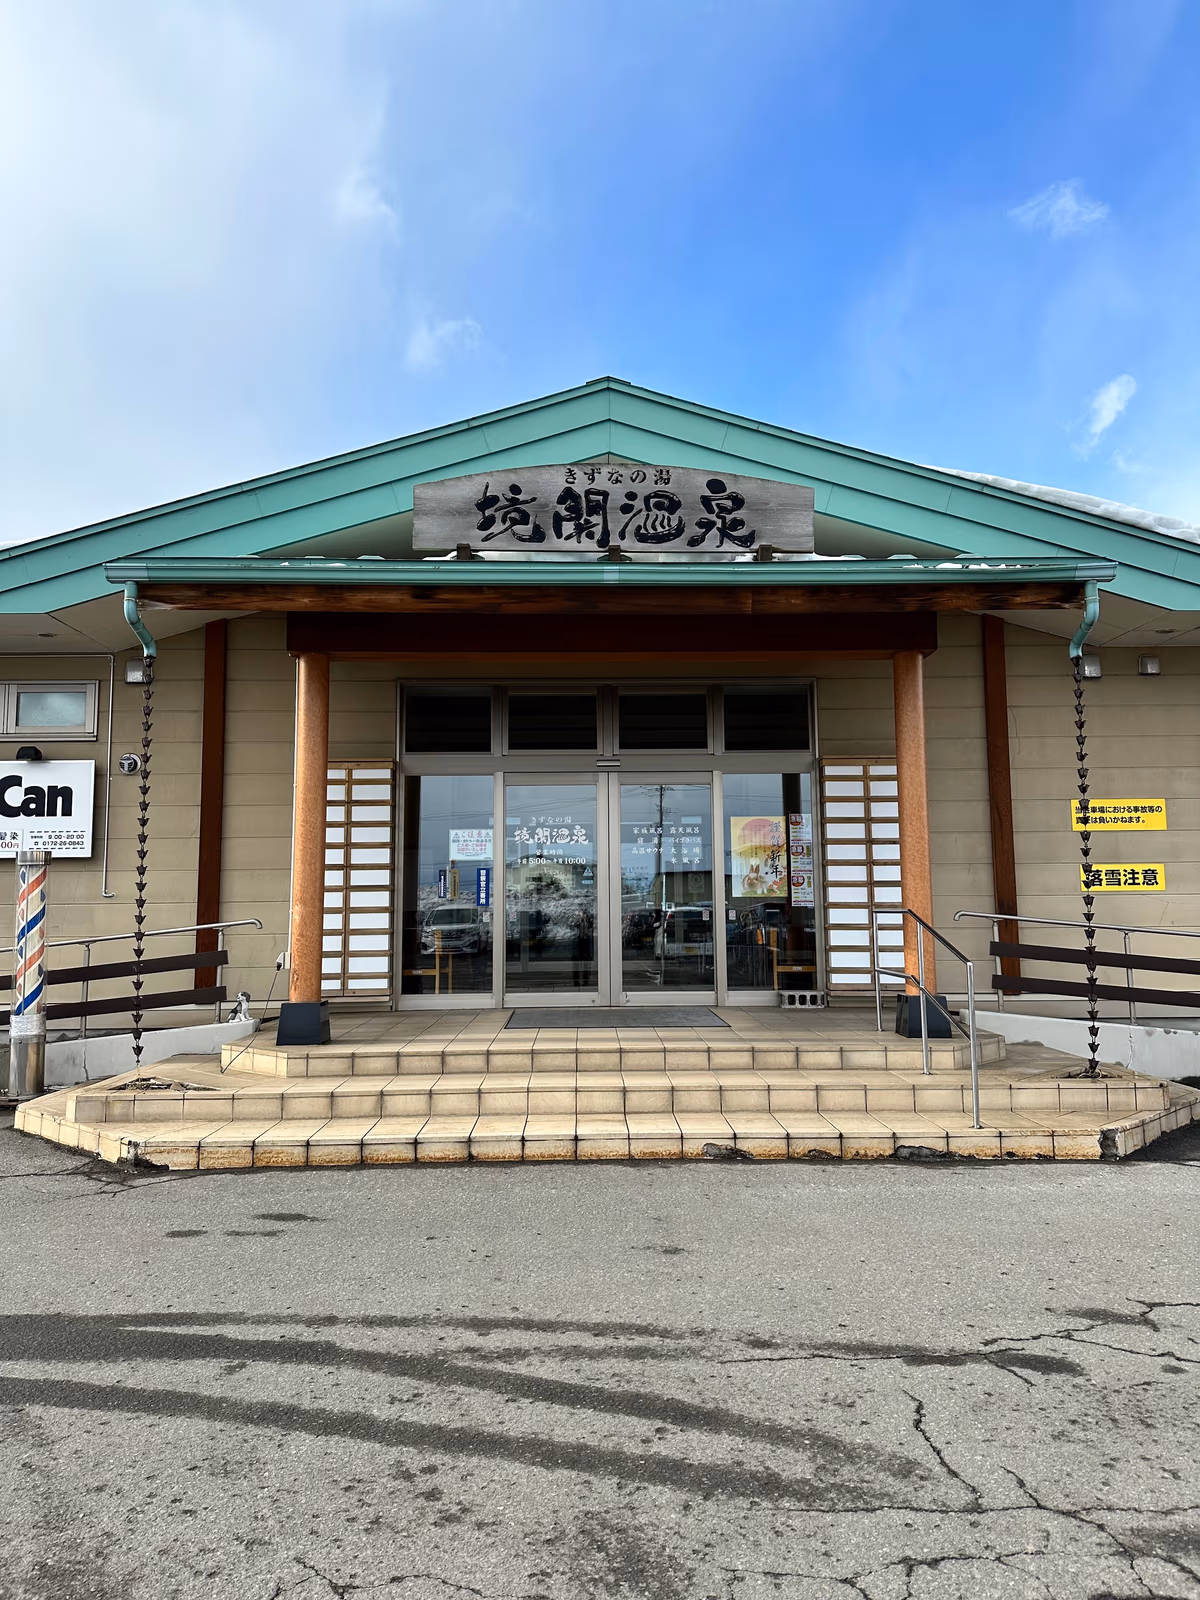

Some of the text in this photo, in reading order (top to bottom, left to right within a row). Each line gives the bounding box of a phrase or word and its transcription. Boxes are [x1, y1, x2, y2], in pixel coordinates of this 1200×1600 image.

[563, 467, 671, 486] きずなの湯
[473, 478, 757, 549] 境関温泉
[0, 774, 73, 818] Can
[531, 816, 572, 824] きずなの湯
[1075, 816, 1146, 825] は負いかねます。
[514, 825, 589, 845] 境関温泉
[1086, 869, 1159, 887] 落雪注意
